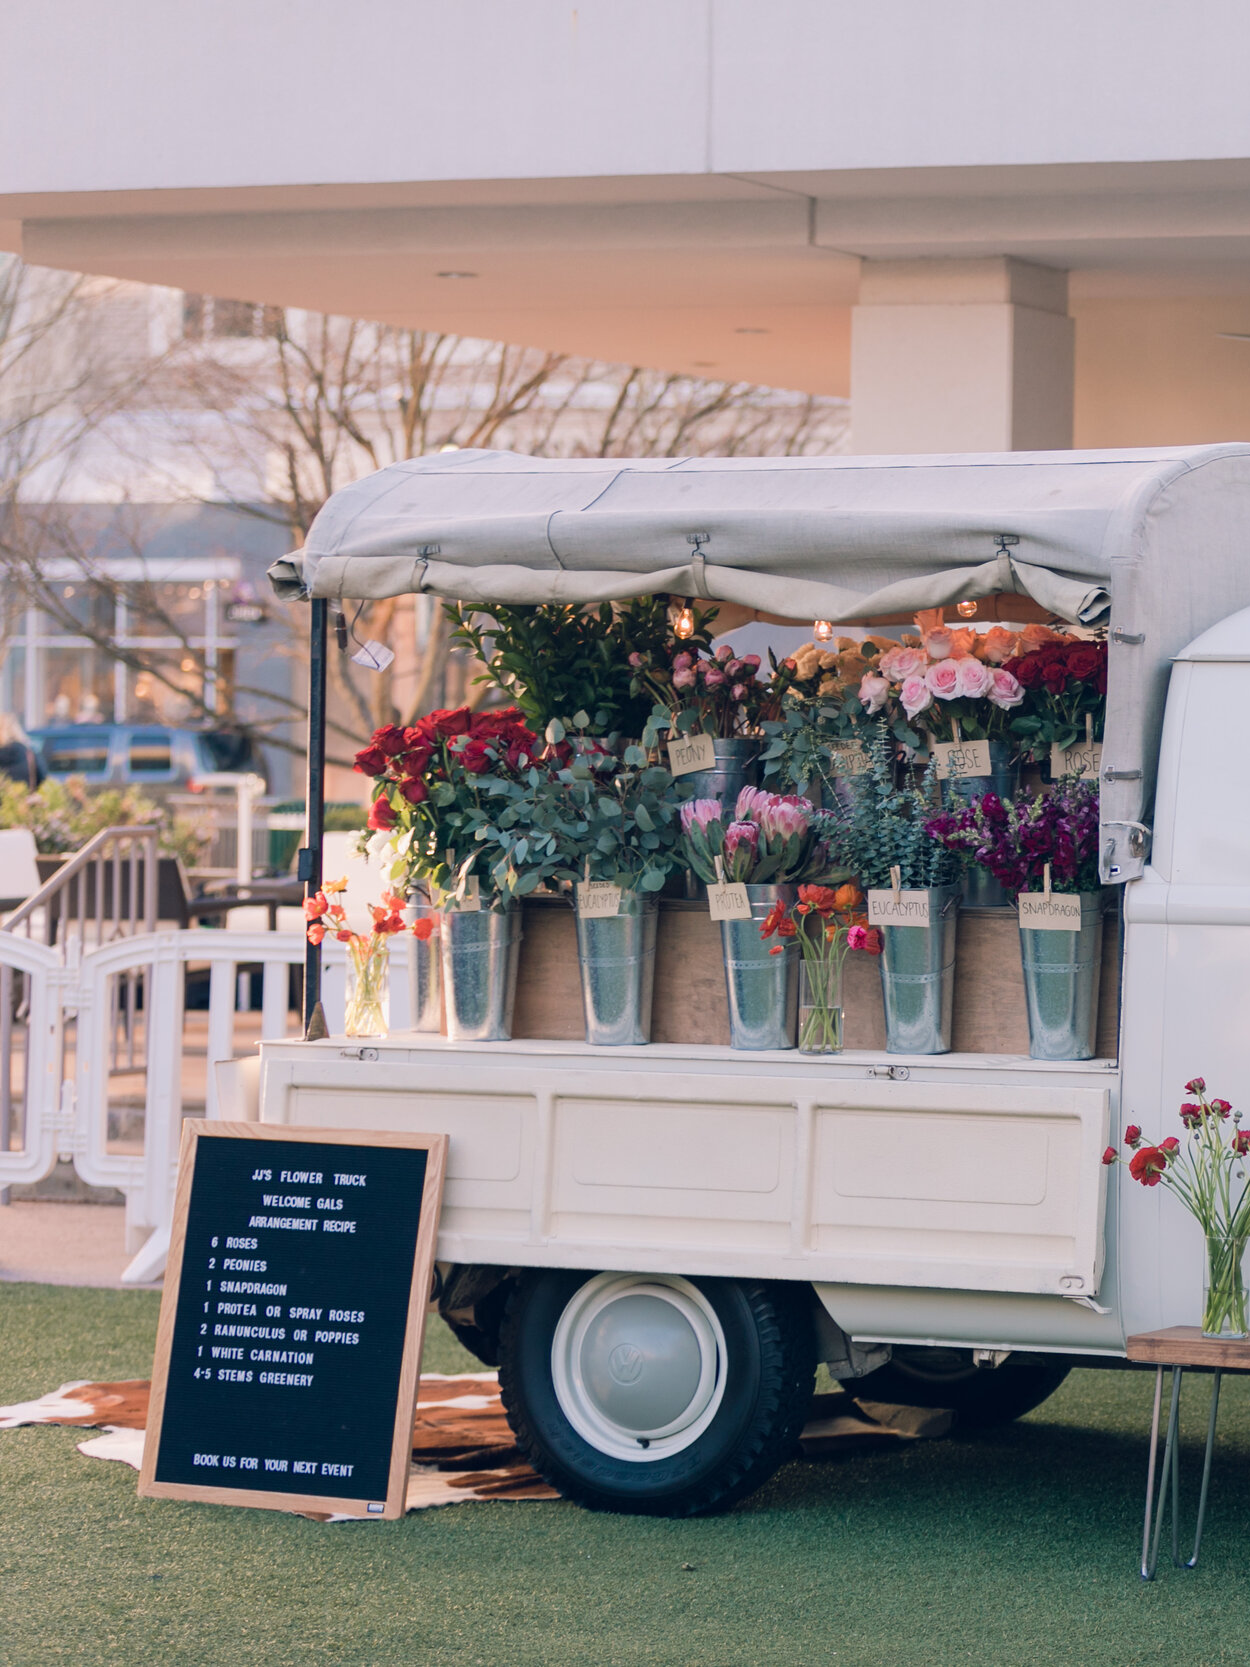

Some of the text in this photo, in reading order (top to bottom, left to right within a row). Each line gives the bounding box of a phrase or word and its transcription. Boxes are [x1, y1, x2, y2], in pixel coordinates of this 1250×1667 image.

[675, 743, 706, 766] PEONY
[1064, 750, 1100, 773] ROSE
[715, 892, 746, 912] PROTEA
[871, 900, 929, 919] EUCALYPTUS
[1022, 901, 1081, 918] SNAPDRAGON
[252, 1169, 367, 1187] JJ'S FLOWER TRUCK
[262, 1194, 344, 1211] WELCOME GALS
[248, 1215, 357, 1233] ARRANGEMENT RECIPE
[211, 1236, 258, 1250] 6 ROSES
[208, 1257, 267, 1272] 2 PEONIES
[206, 1279, 288, 1297] 1 SNAPDRAGON
[203, 1301, 365, 1323] 1 PROTEA OR SPRAY ROSES
[200, 1323, 360, 1345] 2 RANUNCULUS OR POPPIES
[197, 1345, 314, 1365] 1 WHITE CARNATION
[193, 1367, 314, 1387] 4-5 STEMS GREENERY
[193, 1453, 354, 1478] BOOK US FOR YOUR NEXT EVENT
